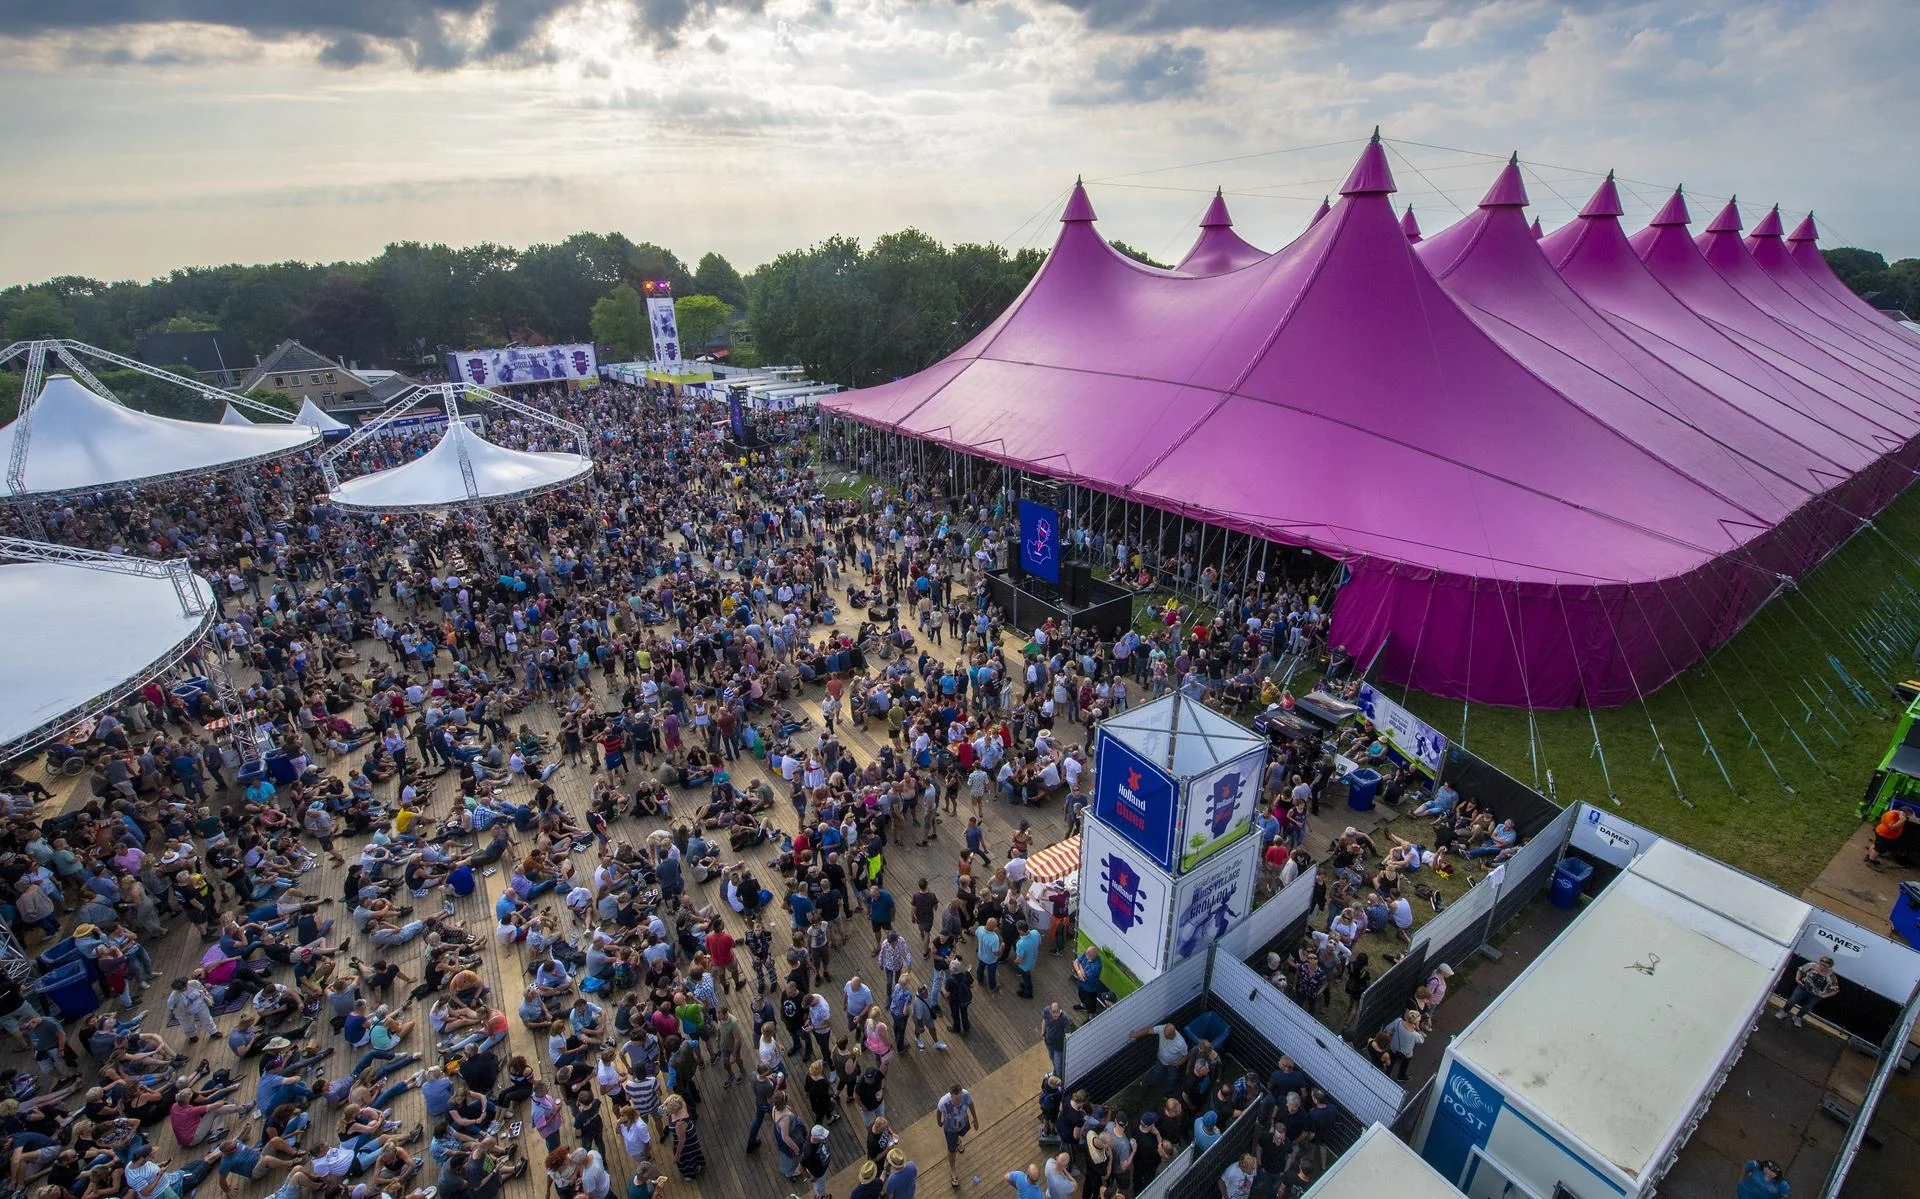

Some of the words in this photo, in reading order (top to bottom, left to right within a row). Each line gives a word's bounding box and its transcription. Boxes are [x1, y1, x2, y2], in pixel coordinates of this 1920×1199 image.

[1118, 783, 1146, 811] Holland
[1599, 826, 1630, 846] DAMES
[1817, 929, 1861, 953] DAMES
[1443, 1093, 1487, 1130] POST
